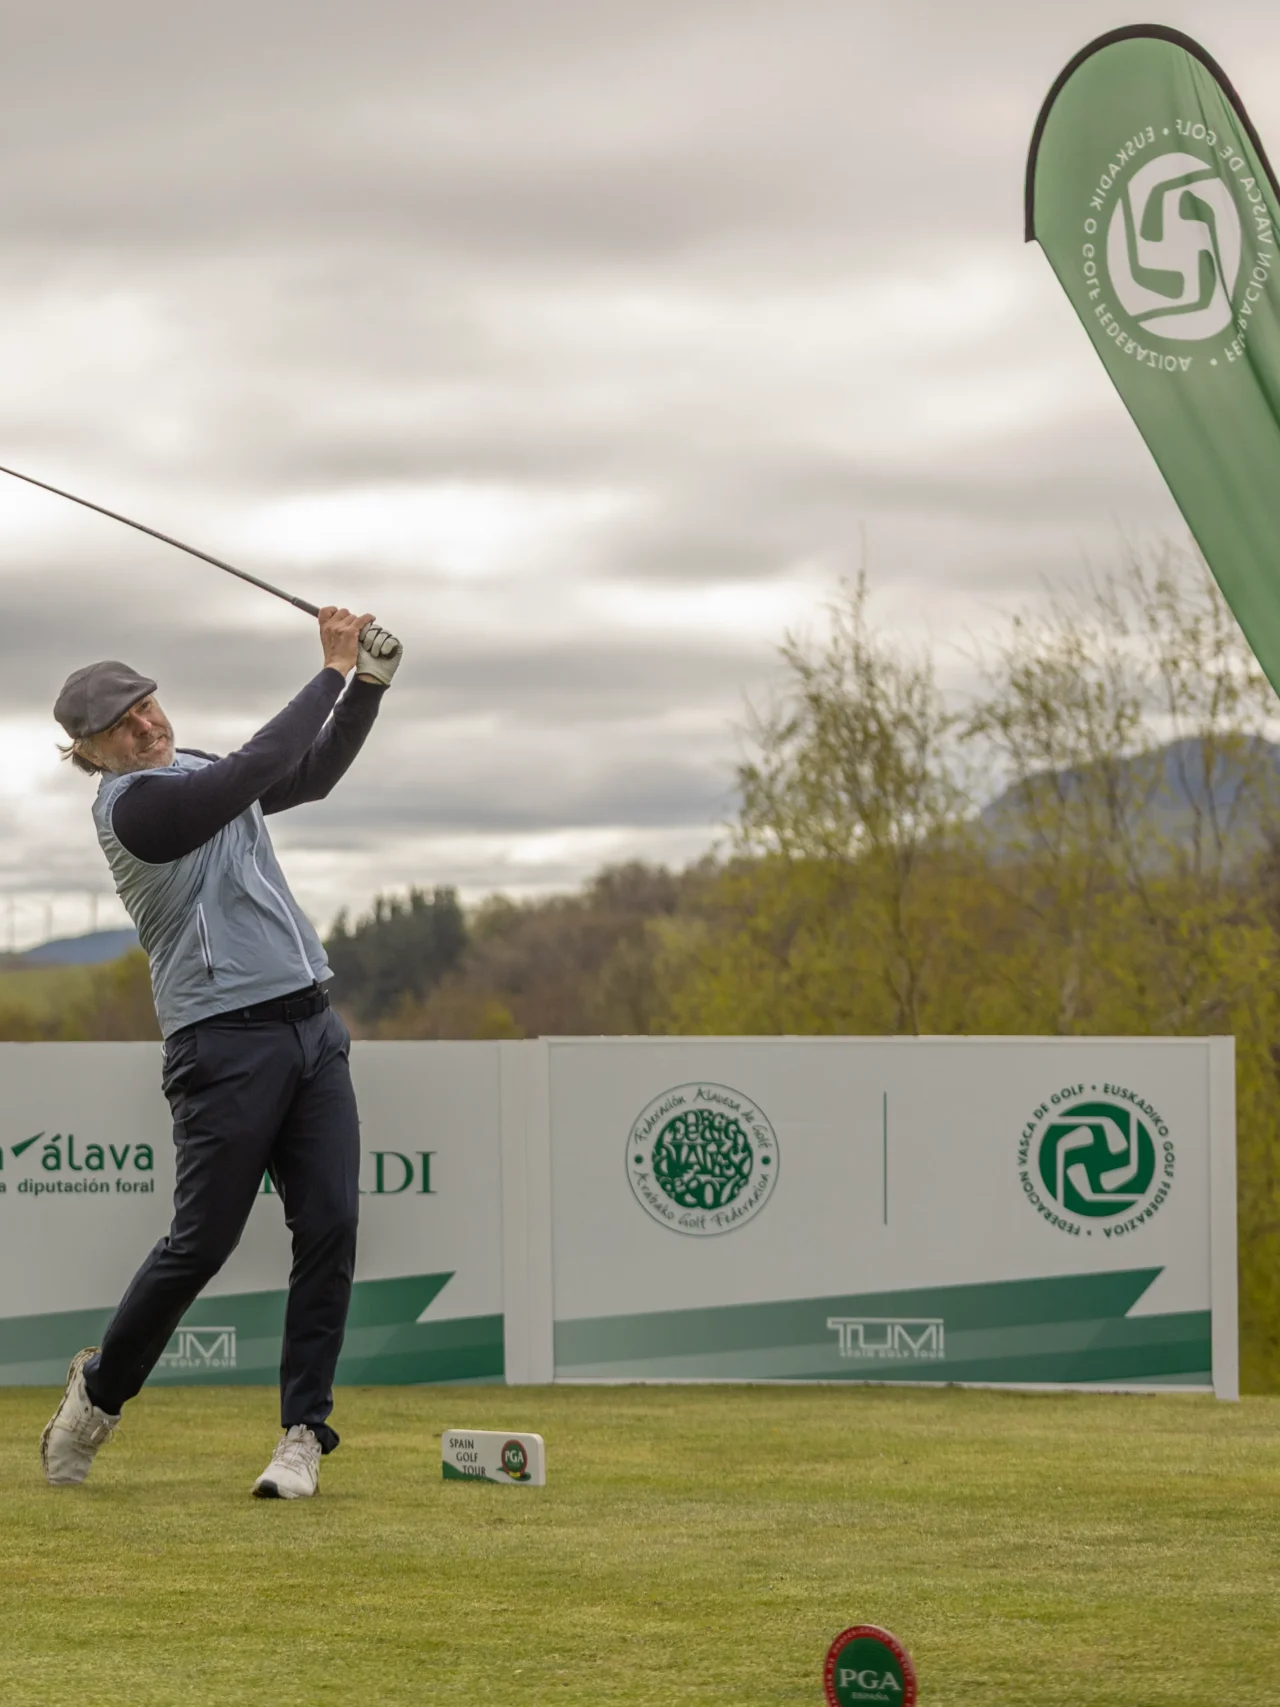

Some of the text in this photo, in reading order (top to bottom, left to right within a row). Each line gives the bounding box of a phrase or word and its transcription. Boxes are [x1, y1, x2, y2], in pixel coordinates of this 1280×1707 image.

[1017, 1121, 1037, 1166] VASCA
[1033, 1102, 1050, 1121] DE
[1050, 1083, 1085, 1105] GOLF
[42, 1133, 154, 1171] álava
[1103, 1083, 1176, 1239] EUSKADIKO GOLF FEDERAZIOA
[17, 1178, 110, 1197] diputación
[116, 1178, 155, 1193] foral
[827, 1317, 944, 1349] TUMI
[449, 1438, 474, 1449] SPAIN
[456, 1451, 478, 1463] GOLF
[505, 1449, 524, 1464] PGA
[462, 1465, 486, 1477] TOUR
[838, 1668, 902, 1691] PGA
